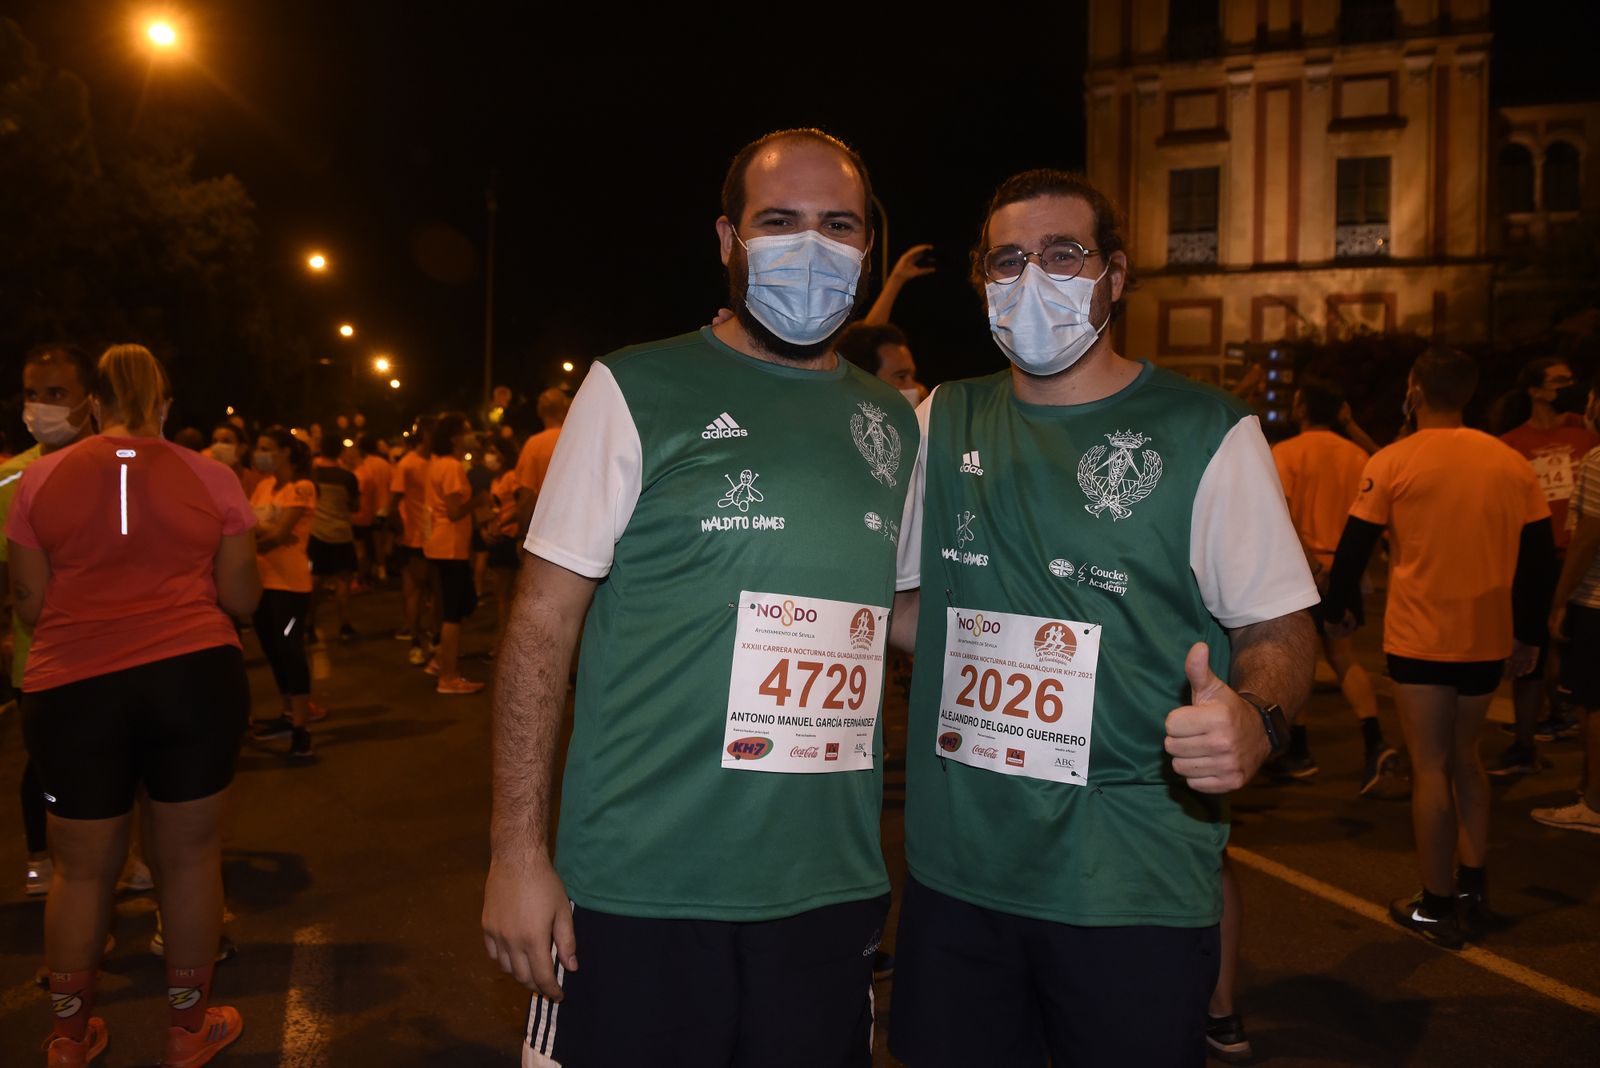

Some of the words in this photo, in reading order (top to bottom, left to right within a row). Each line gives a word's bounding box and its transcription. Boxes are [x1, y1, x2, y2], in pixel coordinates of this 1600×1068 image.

[701, 427, 748, 439] adidas
[701, 515, 749, 532] MALDITO
[752, 513, 785, 531] GAMES
[963, 551, 989, 566] GAMES
[1090, 565, 1129, 582] Coucke's
[1088, 577, 1127, 596] Academy
[741, 642, 761, 650] XXXIII
[763, 644, 792, 654] CARRERA
[794, 647, 826, 658] NOCTURNA
[827, 650, 836, 658] DEL
[1043, 650, 1072, 663] NOCTURNA
[962, 652, 979, 662] CARRERA
[980, 655, 1006, 666] NOCTURNA
[1007, 660, 1018, 668] DEL
[1018, 662, 1063, 675] GUADALQUIVIR
[1078, 671, 1094, 679] 2021
[758, 658, 866, 710] 4729
[956, 665, 1064, 723] 2026
[730, 711, 775, 725] ANTONIO
[777, 715, 814, 727] MANUEL
[816, 715, 842, 728] GARCÍA
[843, 716, 875, 728] FERNÁNDEZ
[940, 709, 979, 727] ALEJANDRO
[980, 719, 1024, 737] DELGADO
[1026, 728, 1087, 747] GUERRERO
[1054, 757, 1076, 767] ABC
